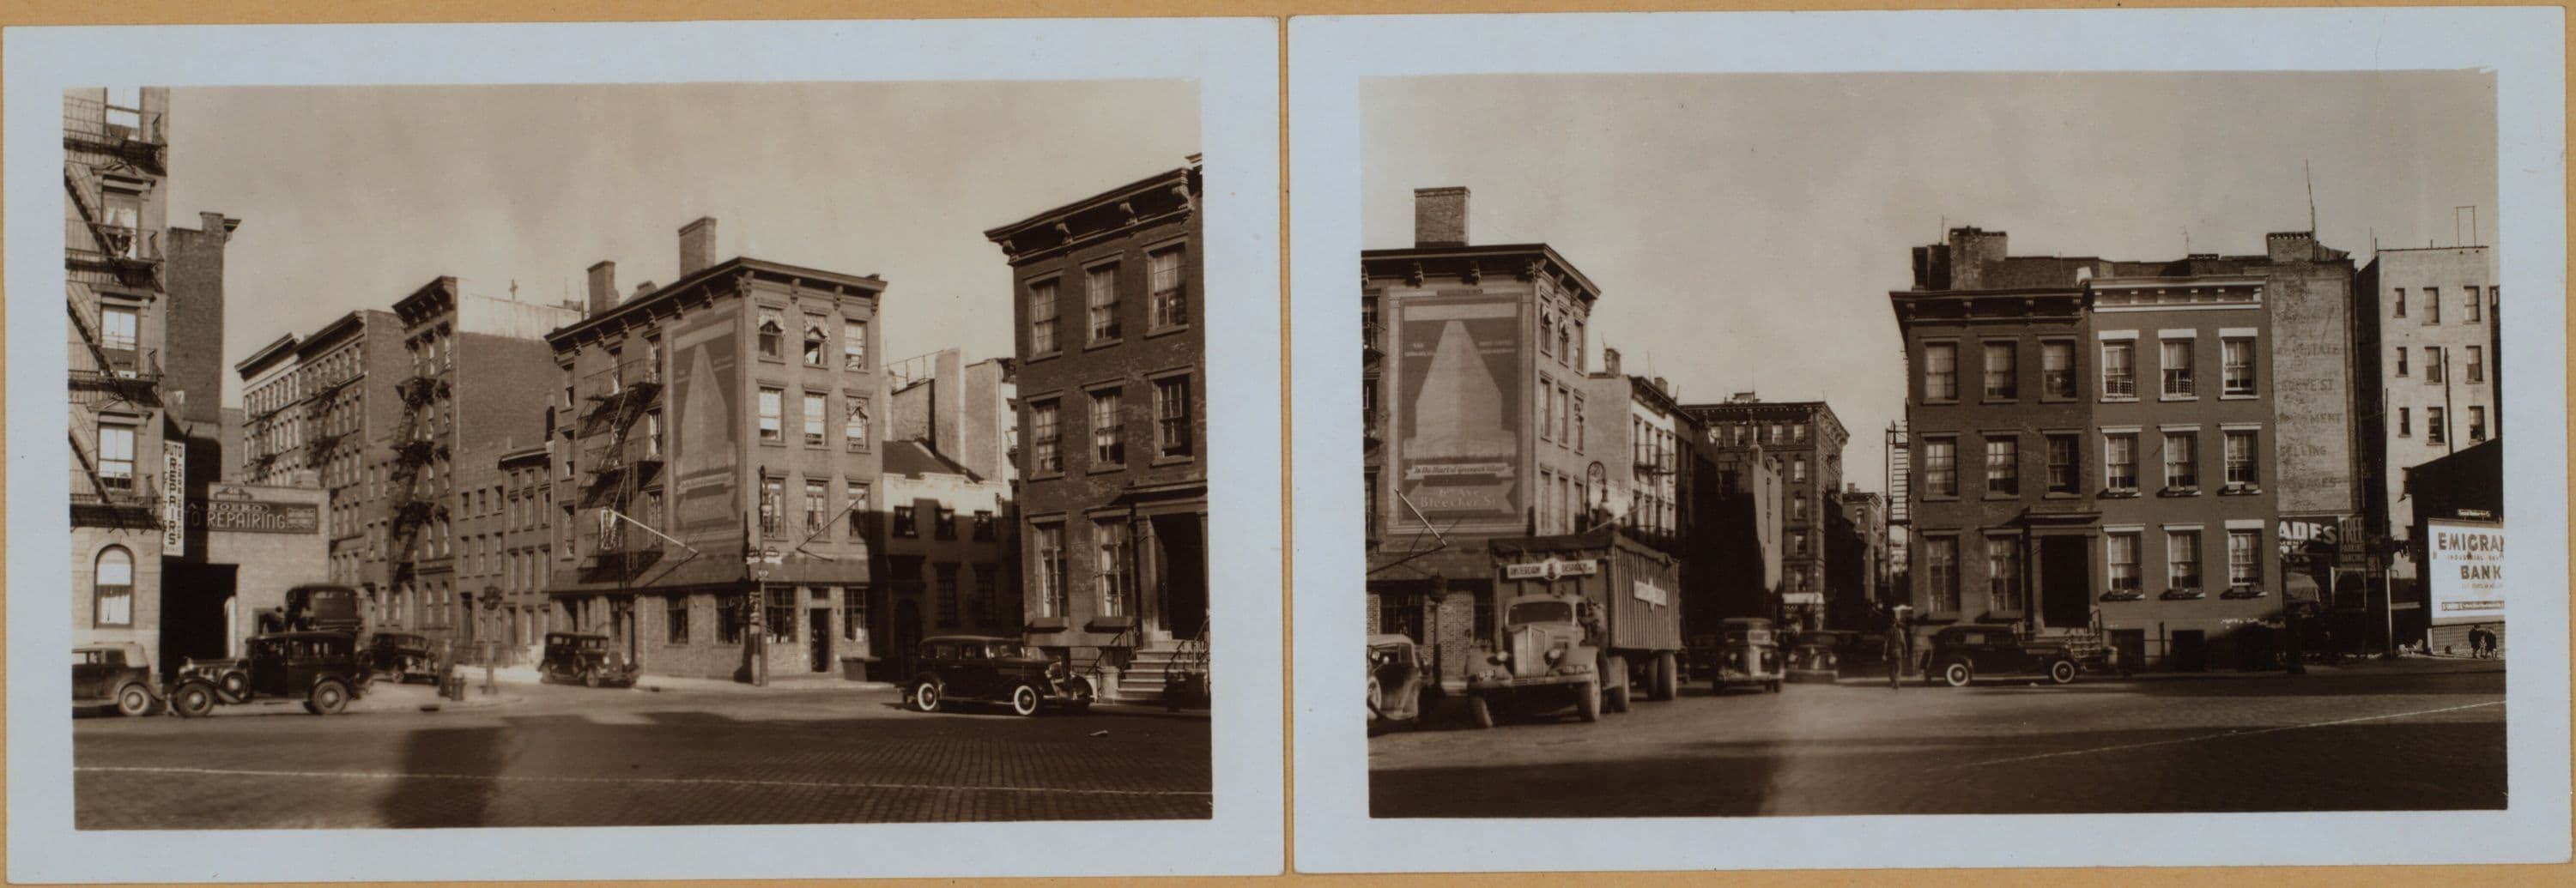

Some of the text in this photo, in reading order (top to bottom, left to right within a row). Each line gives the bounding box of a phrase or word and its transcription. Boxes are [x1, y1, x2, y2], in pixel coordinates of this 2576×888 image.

[168, 457, 177, 546] REPAIRS
[1421, 495, 1477, 508] Bleecker
[207, 513, 286, 529] REPAIRING
[2340, 516, 2363, 543] FREE
[2460, 565, 2502, 580] BANK
